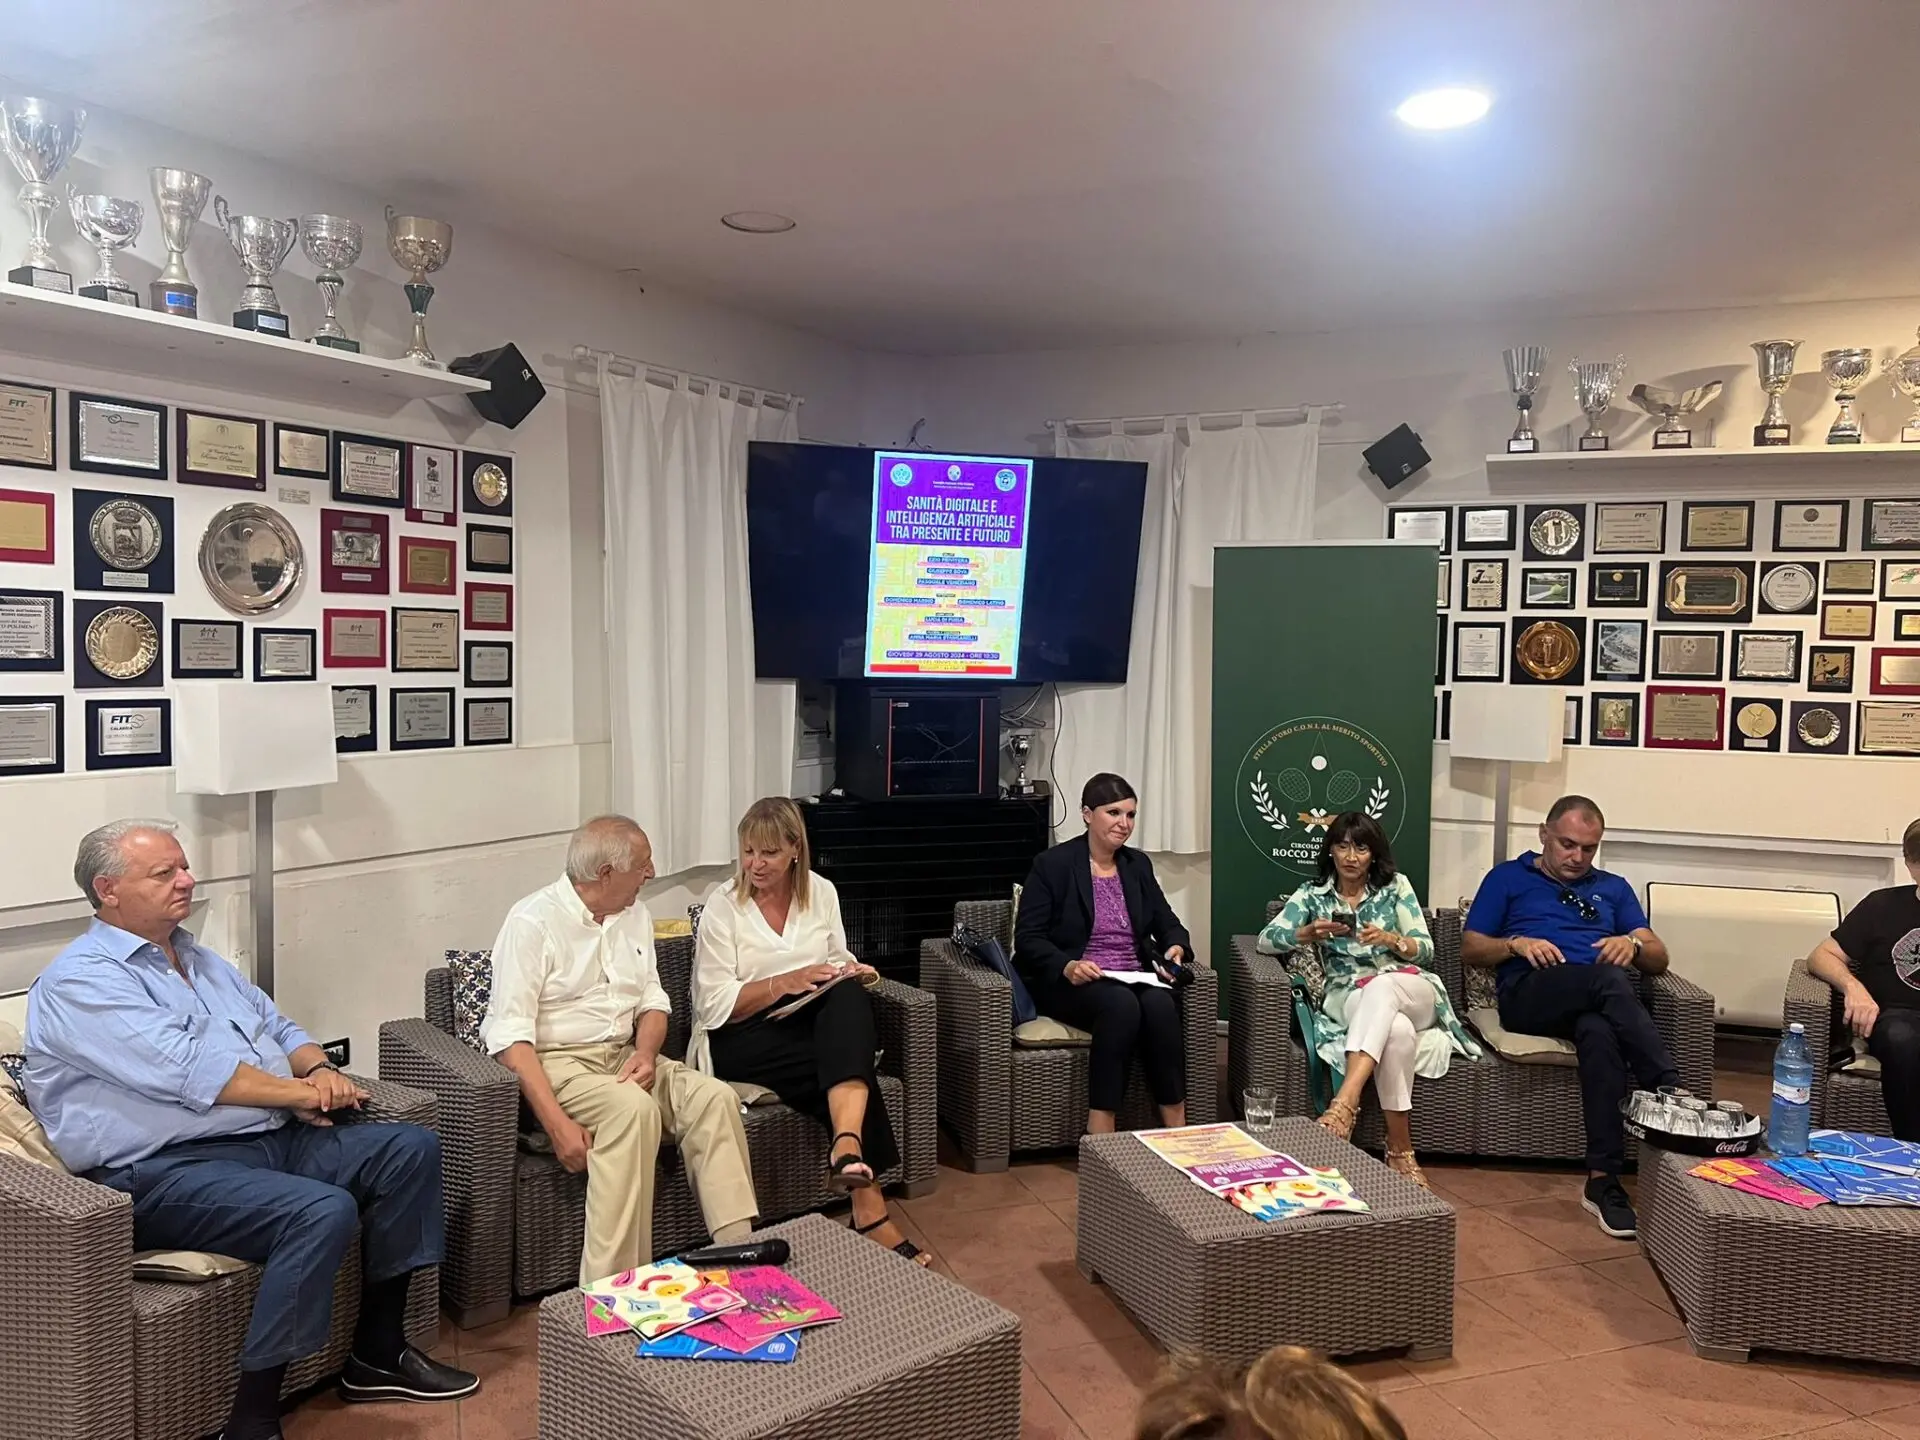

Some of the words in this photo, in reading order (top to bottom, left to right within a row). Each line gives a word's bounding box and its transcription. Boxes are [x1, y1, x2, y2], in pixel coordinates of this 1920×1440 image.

[907, 495, 943, 510] SANITÀ
[945, 498, 989, 512] DIGITALE
[991, 500, 998, 513] E
[886, 510, 955, 526] INTELLIGENZA
[957, 513, 1016, 528] ARTIFICIALE
[890, 525, 910, 539] TRA
[912, 526, 962, 541] PRESENTE
[964, 528, 970, 541] E
[973, 528, 1010, 542] FUTURO
[111, 715, 132, 723] FIT
[1253, 740, 1273, 761] STELLA
[1272, 728, 1292, 742] D'ORO
[1332, 724, 1360, 741] MERITO
[1359, 737, 1388, 767] SPORTIVO
[1272, 848, 1308, 858] ROCCO
[1715, 1140, 1749, 1153] Coca-Cola
